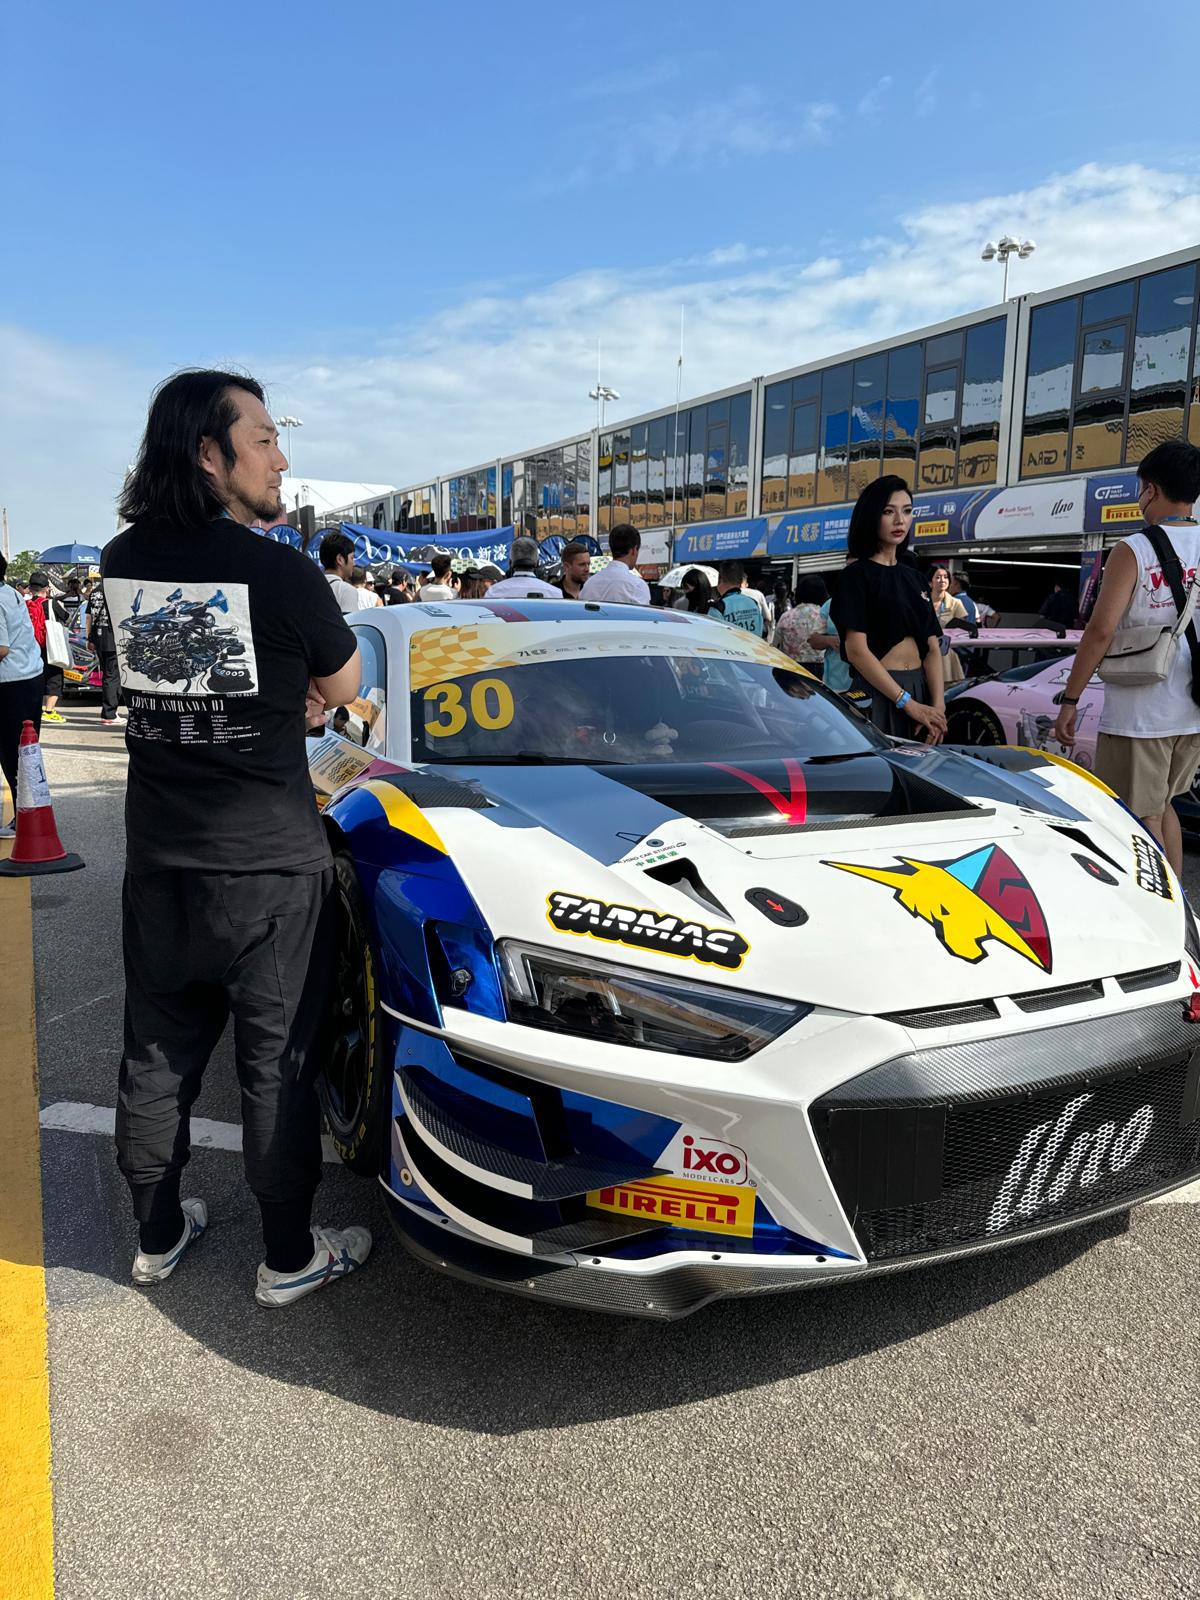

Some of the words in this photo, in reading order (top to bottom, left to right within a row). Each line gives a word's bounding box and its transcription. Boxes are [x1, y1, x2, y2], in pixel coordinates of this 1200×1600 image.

[1105, 507, 1142, 520] PIRELL
[423, 678, 515, 739] 30
[553, 894, 736, 954] TARMAC
[682, 1135, 741, 1175] ixo
[682, 1171, 736, 1185] MODELCARS
[599, 1179, 740, 1226] PIRELLI
